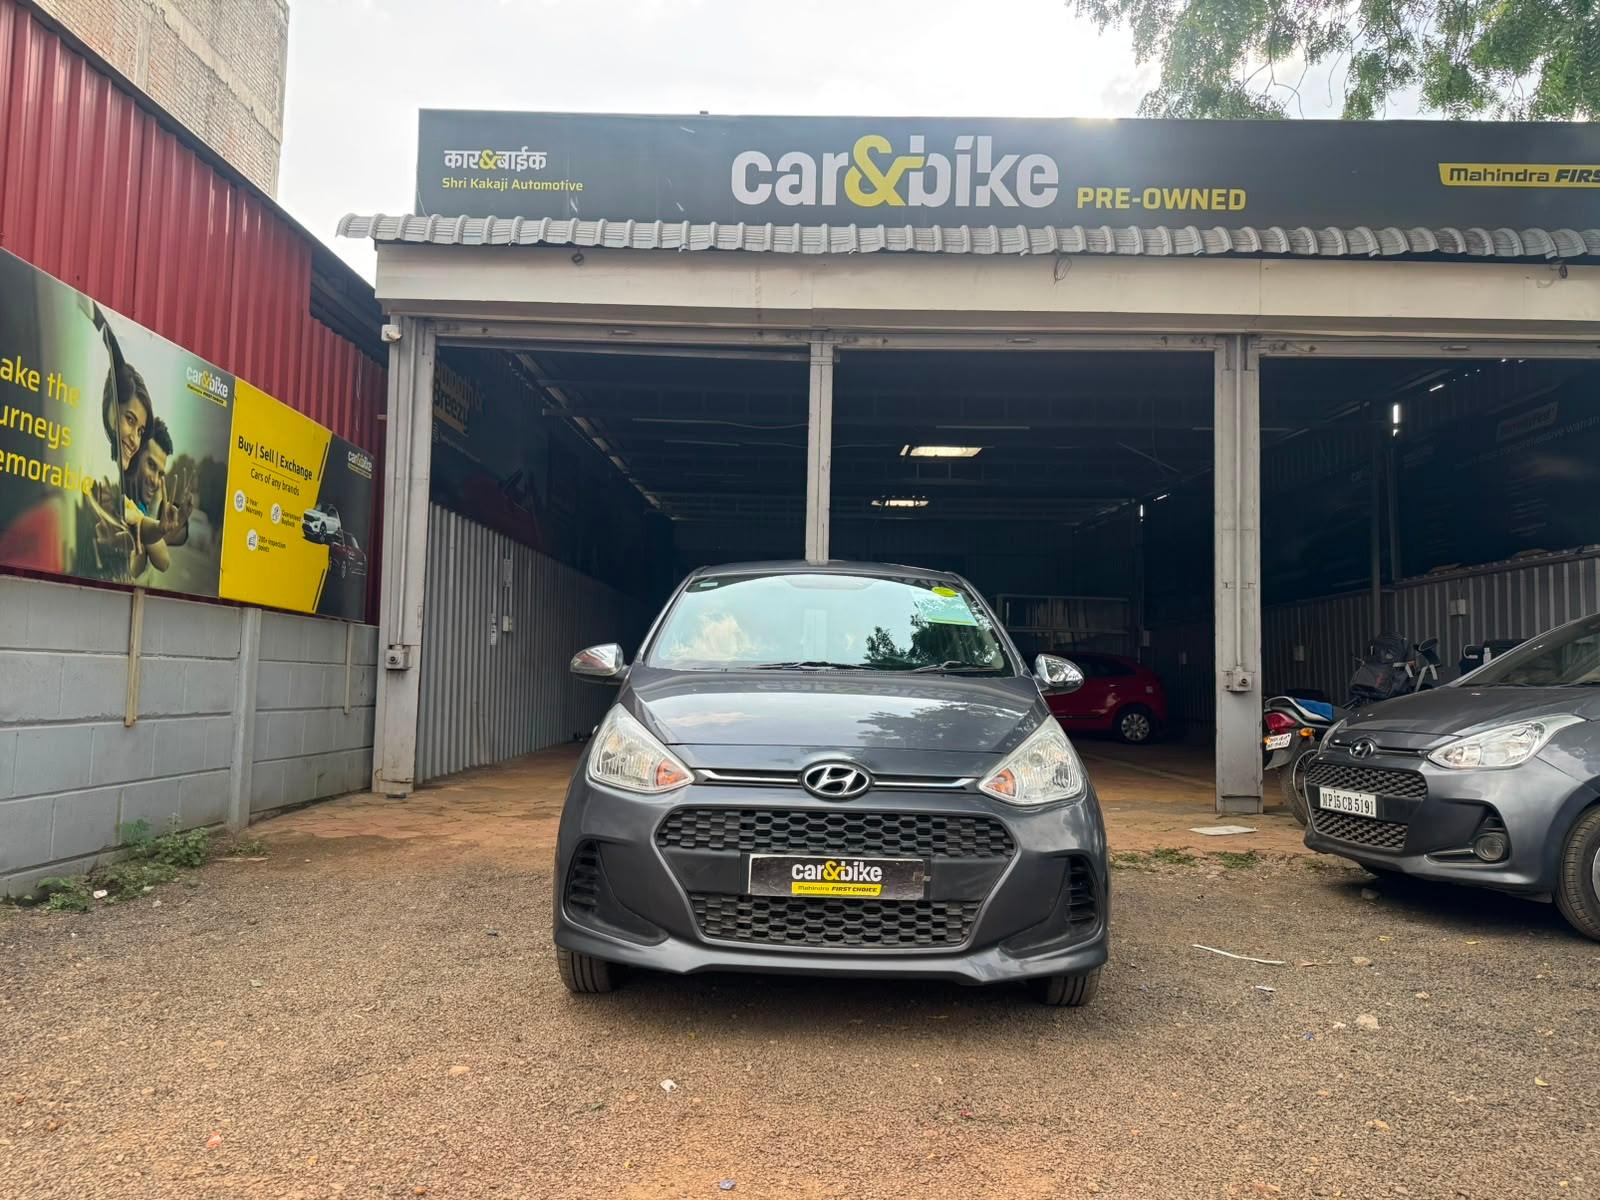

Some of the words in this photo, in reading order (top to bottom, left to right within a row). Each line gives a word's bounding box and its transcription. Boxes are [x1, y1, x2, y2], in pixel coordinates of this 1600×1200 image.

[443, 146, 548, 172] कार&बाईक
[731, 134, 1060, 209] car&bike
[441, 176, 468, 189] Shri
[470, 177, 508, 191] Kakaji
[511, 179, 584, 192] Automotive
[1450, 167, 1549, 183] Mahindra
[1077, 187, 1247, 211] PRE-OWNED
[47, 372, 81, 408] the
[186, 366, 229, 399] car&bike
[238, 435, 254, 457] Buy
[260, 446, 275, 464] Sell
[280, 455, 314, 481] Exchange
[250, 468, 264, 482] Cars
[264, 474, 272, 485] of
[272, 477, 281, 490] any
[282, 480, 300, 497] brands
[791, 860, 883, 882] car&bike
